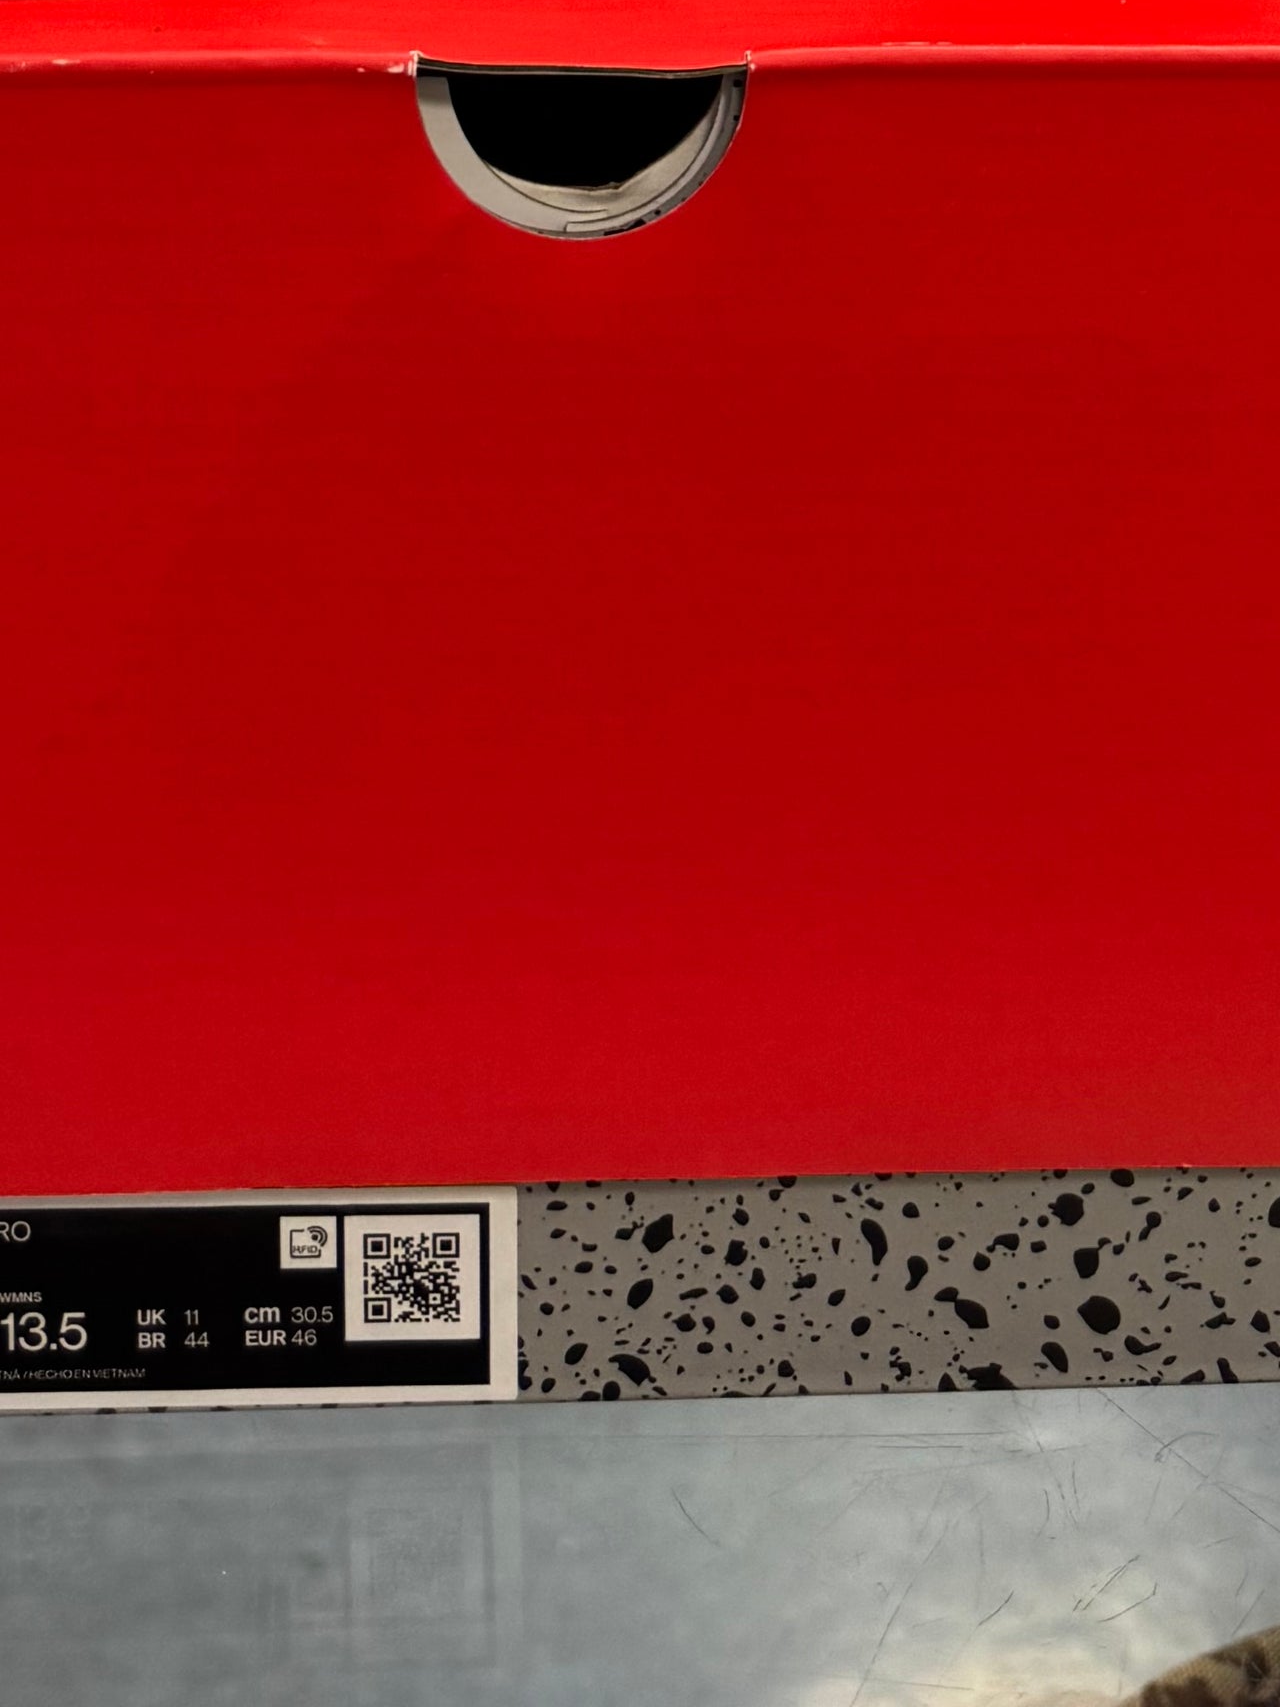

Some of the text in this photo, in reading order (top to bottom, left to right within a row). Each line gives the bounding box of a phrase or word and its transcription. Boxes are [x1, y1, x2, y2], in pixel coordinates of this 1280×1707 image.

[137, 1309, 200, 1326] UK 11
[244, 1306, 334, 1323] cm 30.5
[0, 1311, 88, 1352] 13.5
[245, 1329, 317, 1347] EUR 46
[138, 1332, 210, 1349] BR 44
